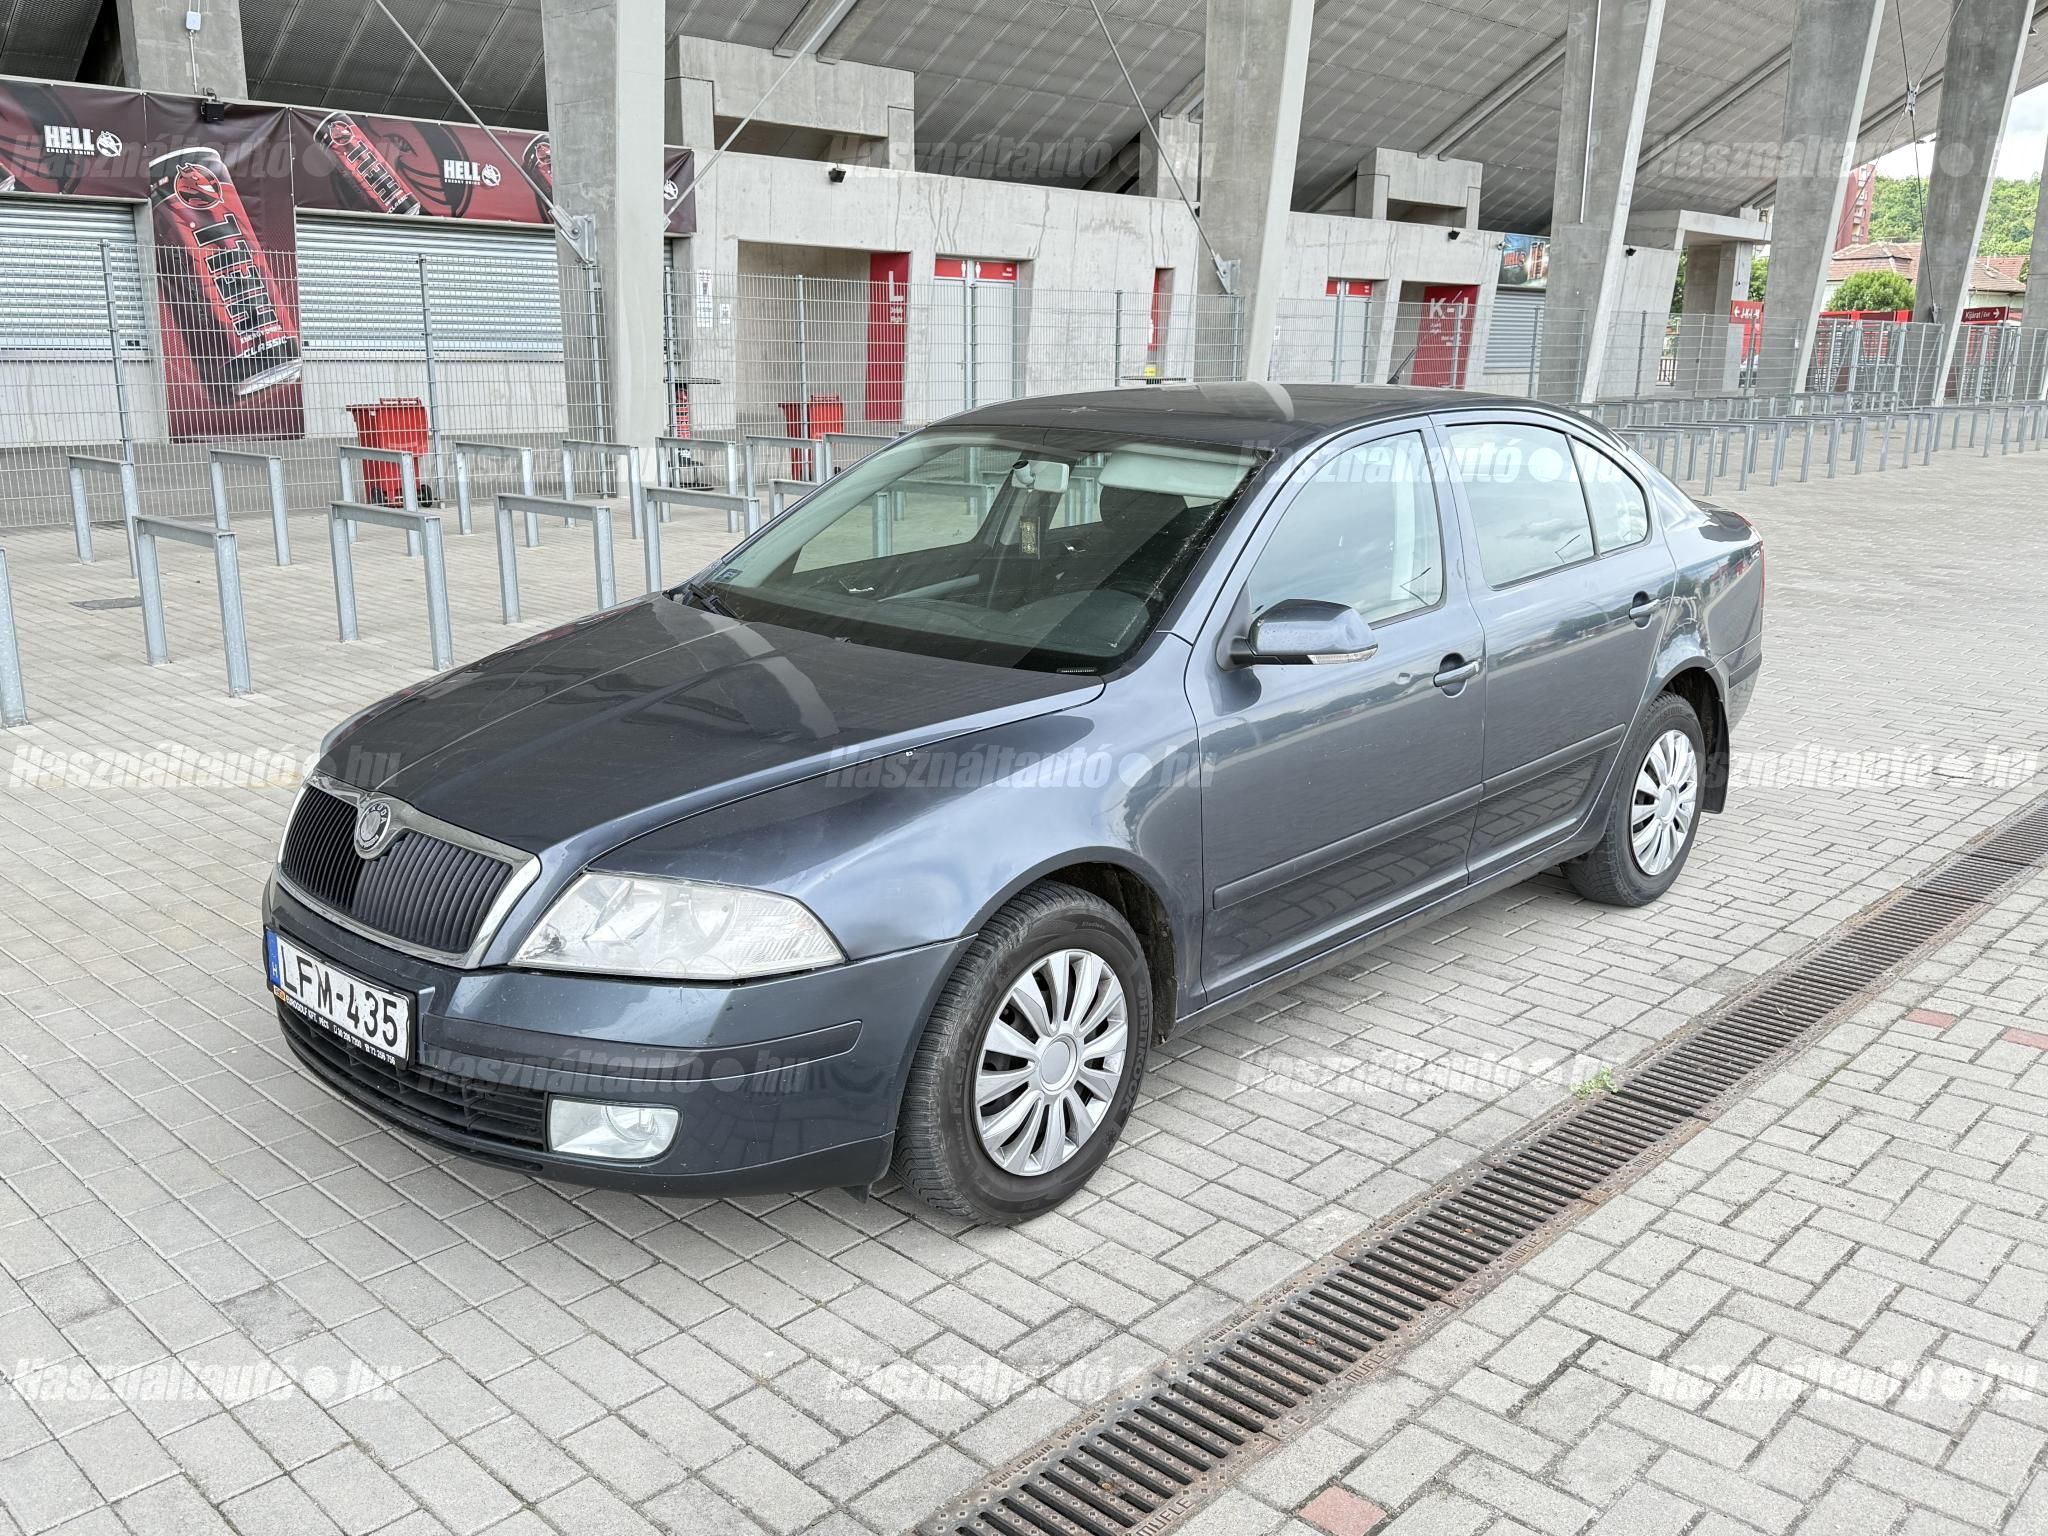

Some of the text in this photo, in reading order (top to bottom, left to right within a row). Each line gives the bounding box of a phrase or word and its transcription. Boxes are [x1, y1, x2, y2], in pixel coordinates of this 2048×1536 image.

[44, 125, 94, 150] HELL
[443, 159, 480, 180] HELL
[193, 213, 279, 336] HELL
[280, 945, 398, 1047] LFM-435
[1504, 1238, 1543, 1263] MUFLE
[1345, 1350, 1392, 1383] MUFLE
[1136, 1497, 1195, 1536] MUFLE
